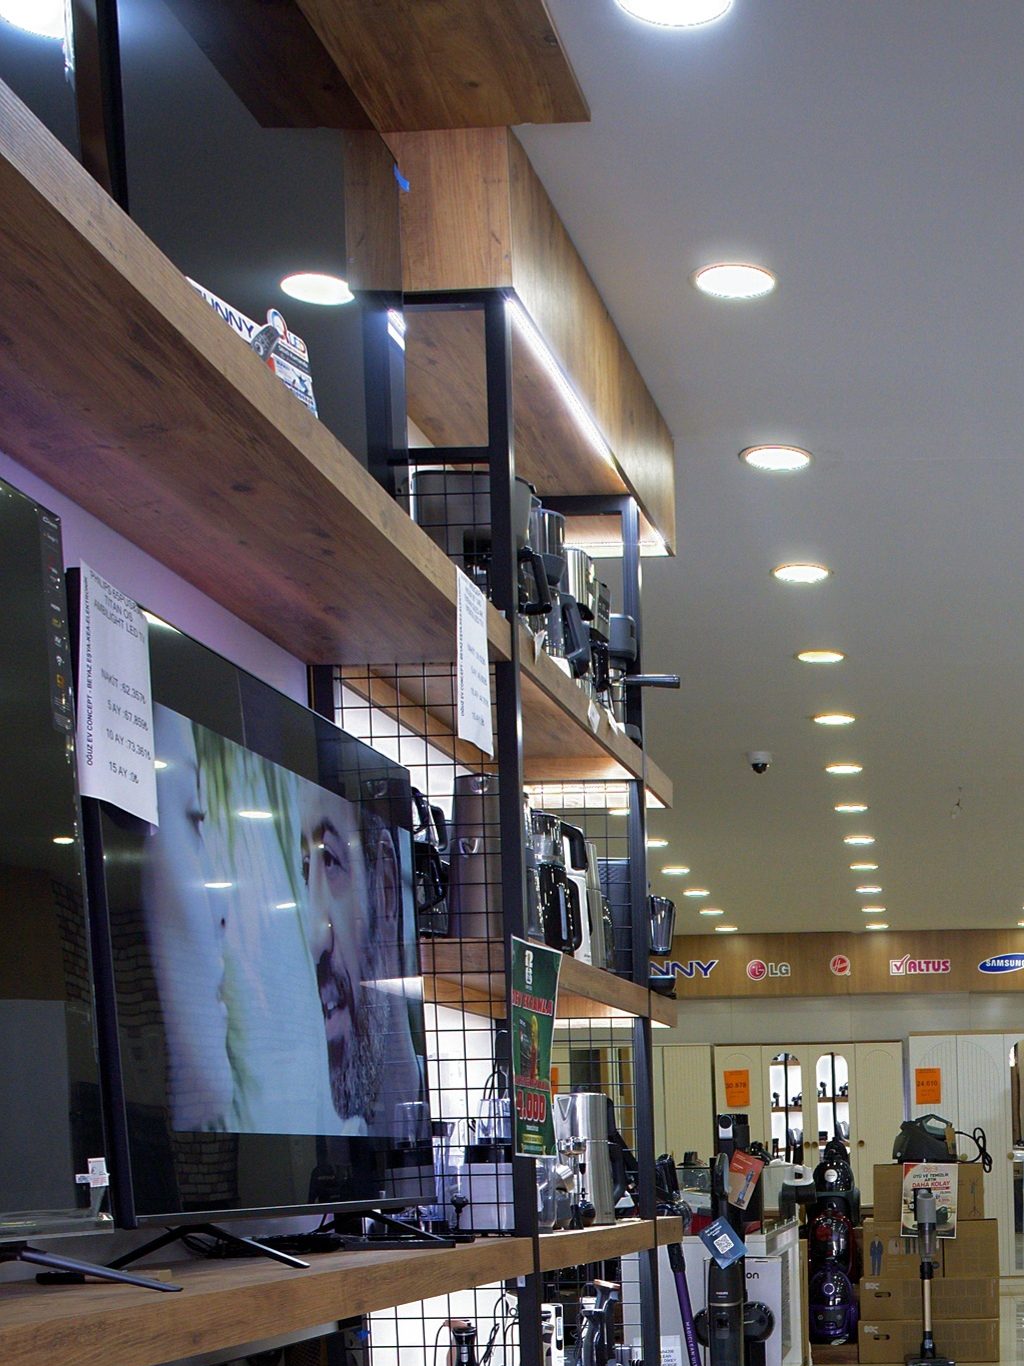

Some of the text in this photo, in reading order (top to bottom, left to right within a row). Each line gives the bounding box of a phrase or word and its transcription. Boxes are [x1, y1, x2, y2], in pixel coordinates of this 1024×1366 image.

[194, 288, 255, 338] NNY
[86, 694, 94, 731] CONCEPT
[650, 960, 791, 977] NNY LG
[907, 959, 950, 973] ALTUS
[911, 1180, 952, 1189] DAHA KOLAY
